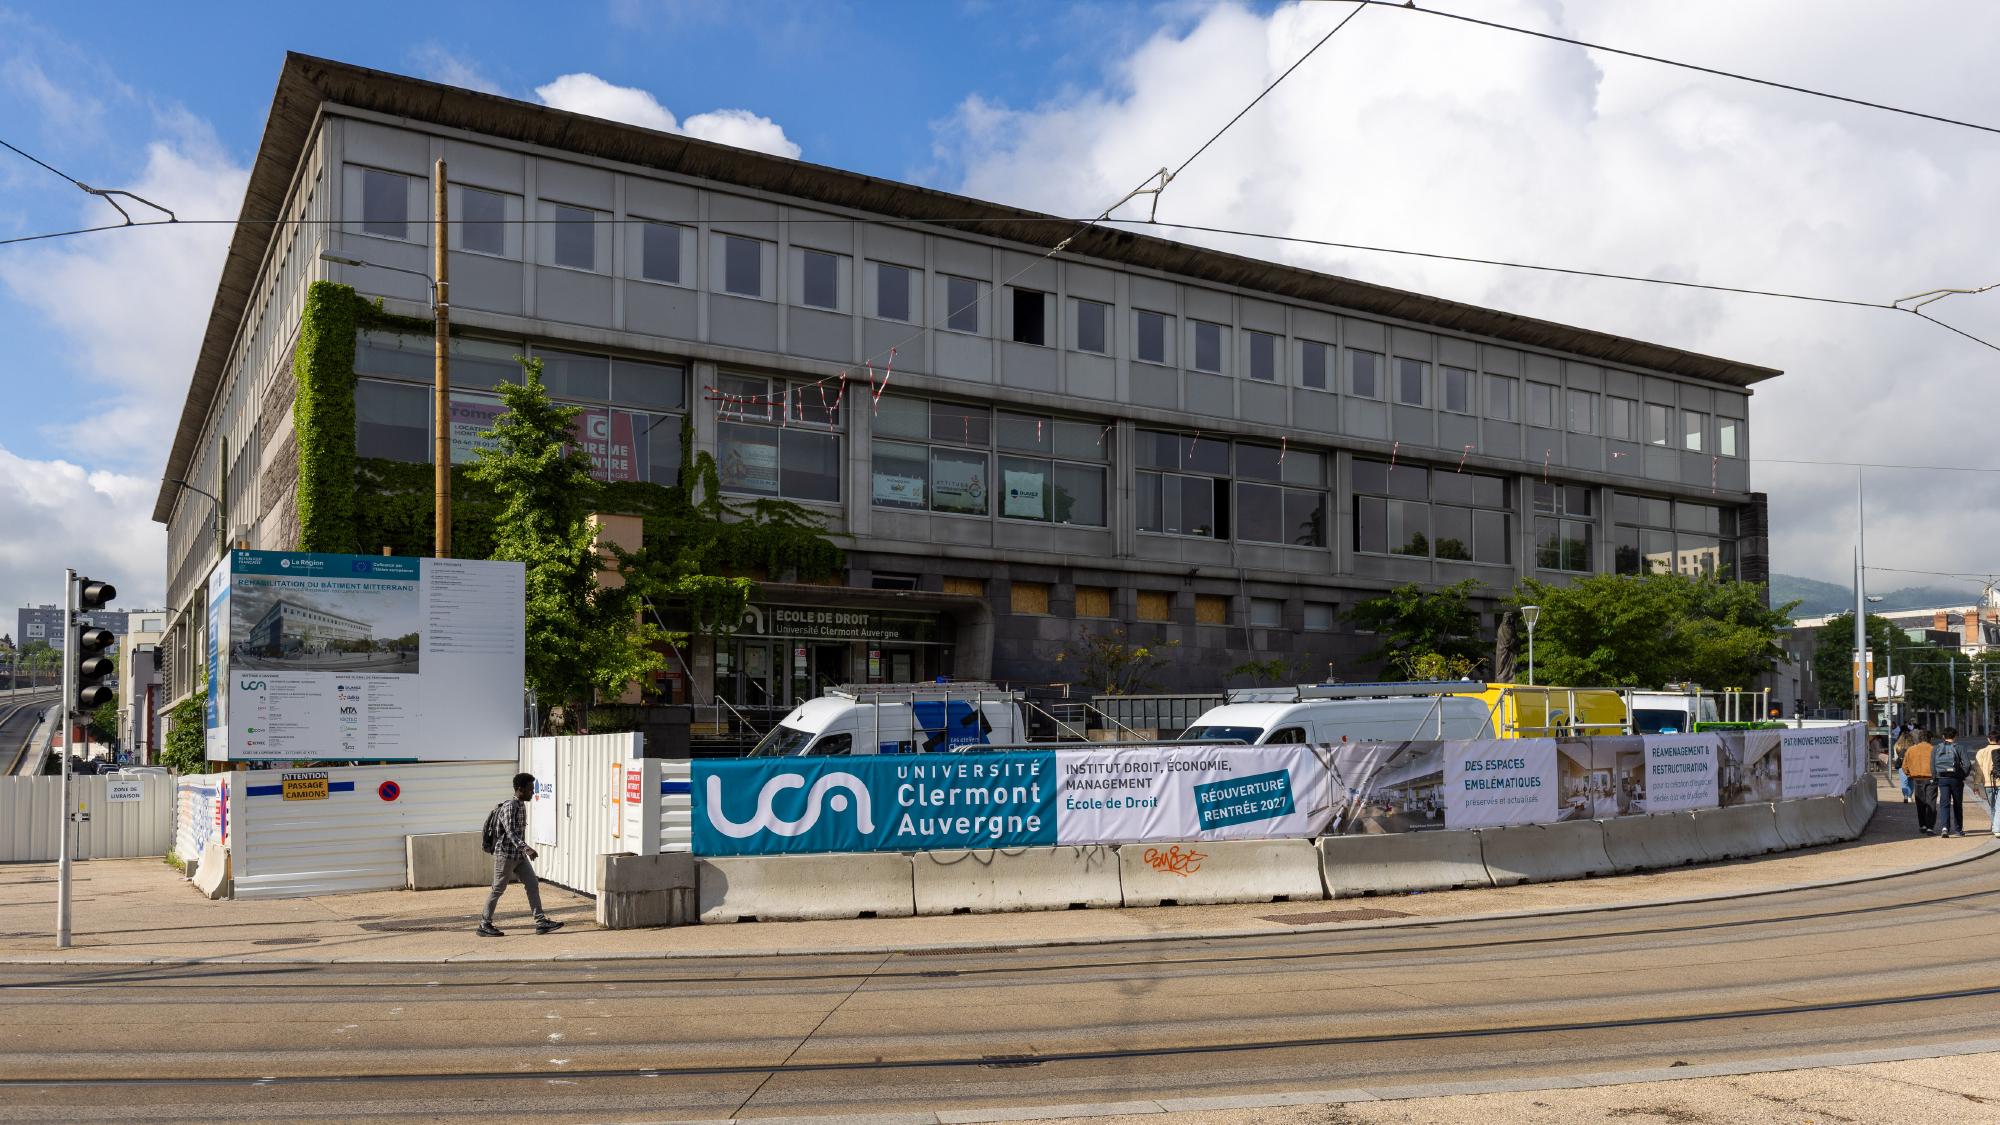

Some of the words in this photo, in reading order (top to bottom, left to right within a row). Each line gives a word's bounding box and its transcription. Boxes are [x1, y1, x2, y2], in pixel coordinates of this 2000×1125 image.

[238, 578, 305, 588] RÉHABILITATION
[321, 580, 360, 590] BÂTIMENT
[363, 583, 414, 592] MITTERRAND
[776, 610, 814, 623] ECOLE
[816, 611, 833, 624] DE
[835, 612, 869, 625] DROIT
[776, 624, 819, 635] Université
[820, 627, 859, 637] Clermont
[861, 628, 899, 639] Auvergne
[1705, 745, 1710, 755] &
[897, 760, 1040, 779] UNIVERSITÉ
[1066, 763, 1119, 775] INSTITUT
[1124, 761, 1164, 774] DROIT,
[1167, 758, 1232, 773] ÉCONOMIE,
[1465, 760, 1483, 772] DES
[1485, 758, 1525, 770] ESPACES
[1652, 762, 1708, 775] RESTRUCTURATION
[283, 772, 328, 781] ATTENTION
[1066, 777, 1153, 791] MANAGEMENT
[1465, 775, 1541, 790] EMBLÉMATIQUES
[287, 781, 324, 790] PASSAGE
[1201, 779, 1285, 803] RÉOUVERTURE
[286, 790, 326, 799] CAMIONS
[897, 782, 1041, 807] Clermont
[1066, 794, 1104, 810] École
[1106, 796, 1121, 809] de
[1126, 795, 1158, 809] Droit
[1500, 796, 1506, 805] et
[1204, 803, 1259, 822] RENTRÉE
[1261, 796, 1287, 812] 2027
[897, 812, 1041, 839] Auvergne
